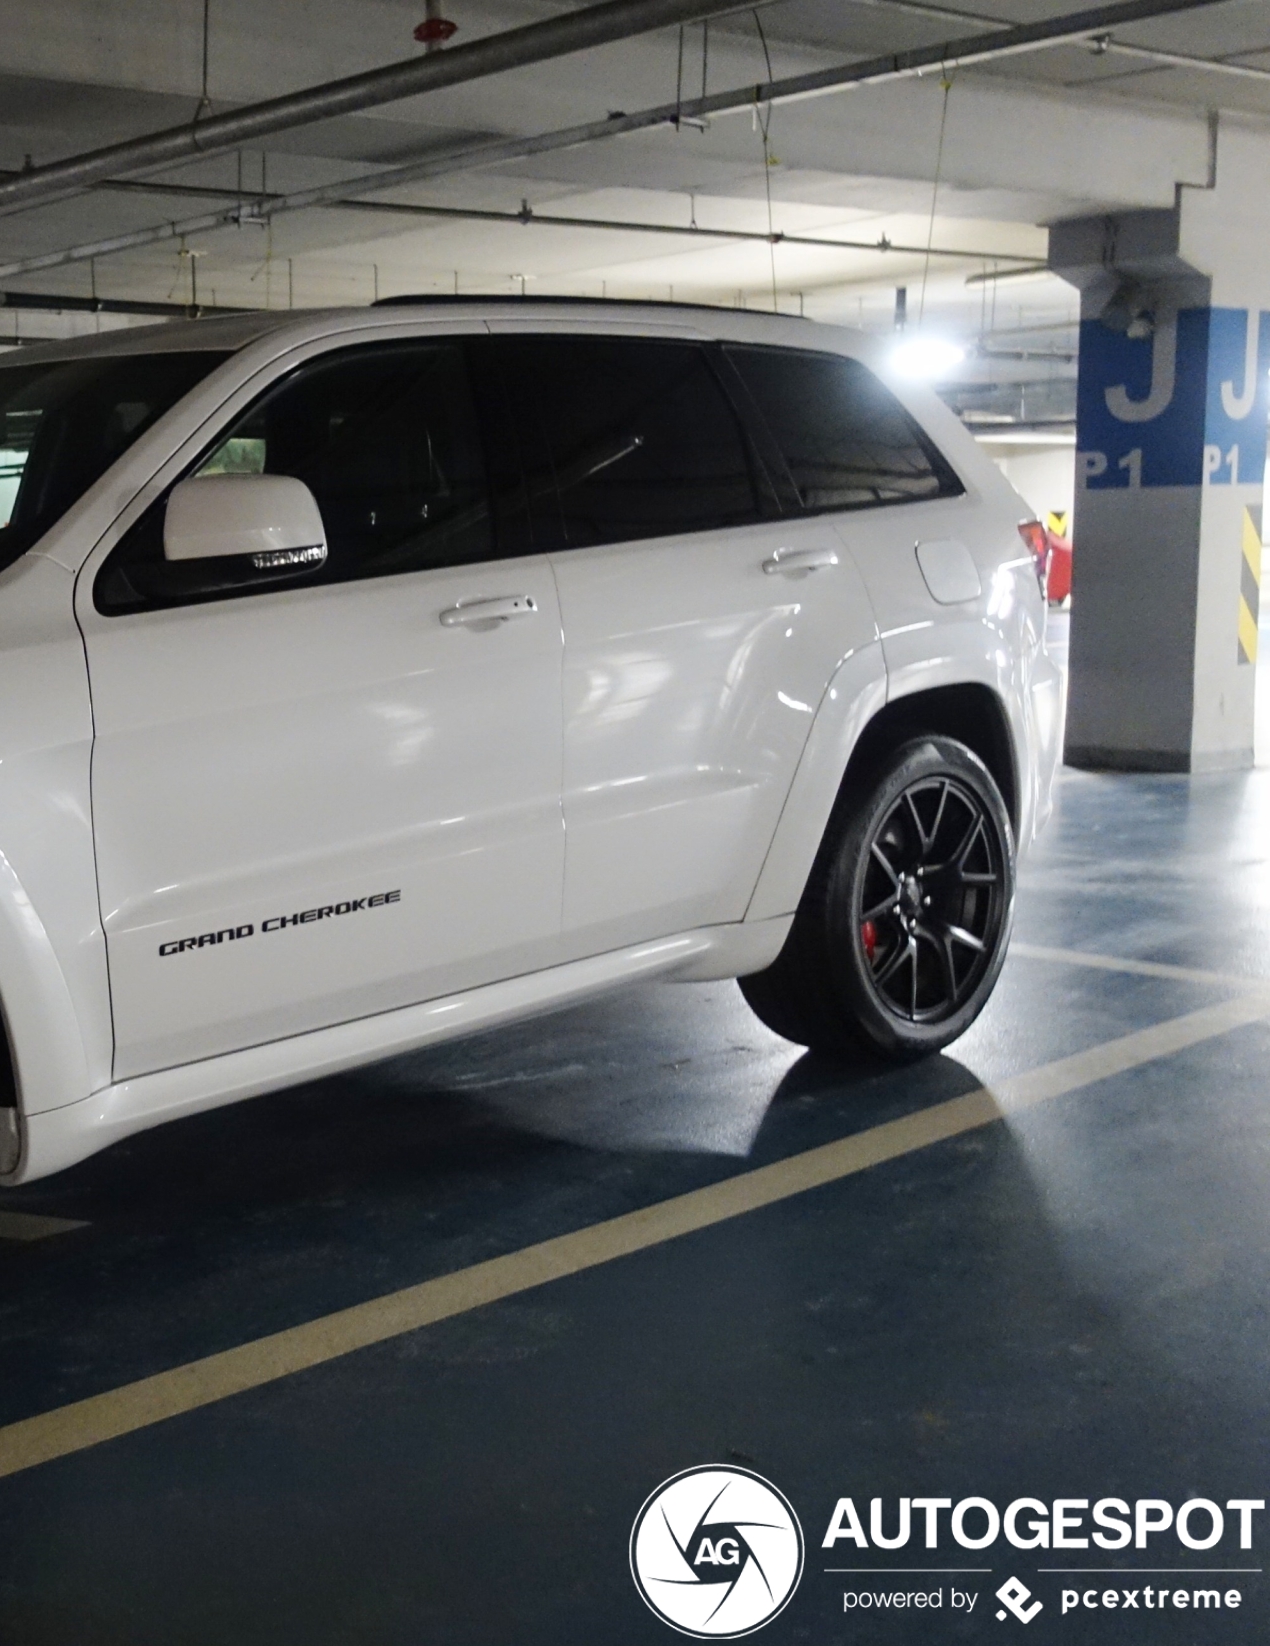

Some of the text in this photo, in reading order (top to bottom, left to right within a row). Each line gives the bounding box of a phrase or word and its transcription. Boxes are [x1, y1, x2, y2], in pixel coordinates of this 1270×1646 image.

[1104, 308, 1178, 423] J
[1221, 308, 1260, 421] J
[1078, 448, 1142, 488] P1
[1202, 443, 1239, 486] P1
[158, 889, 402, 957] GRAND CHEROKEE
